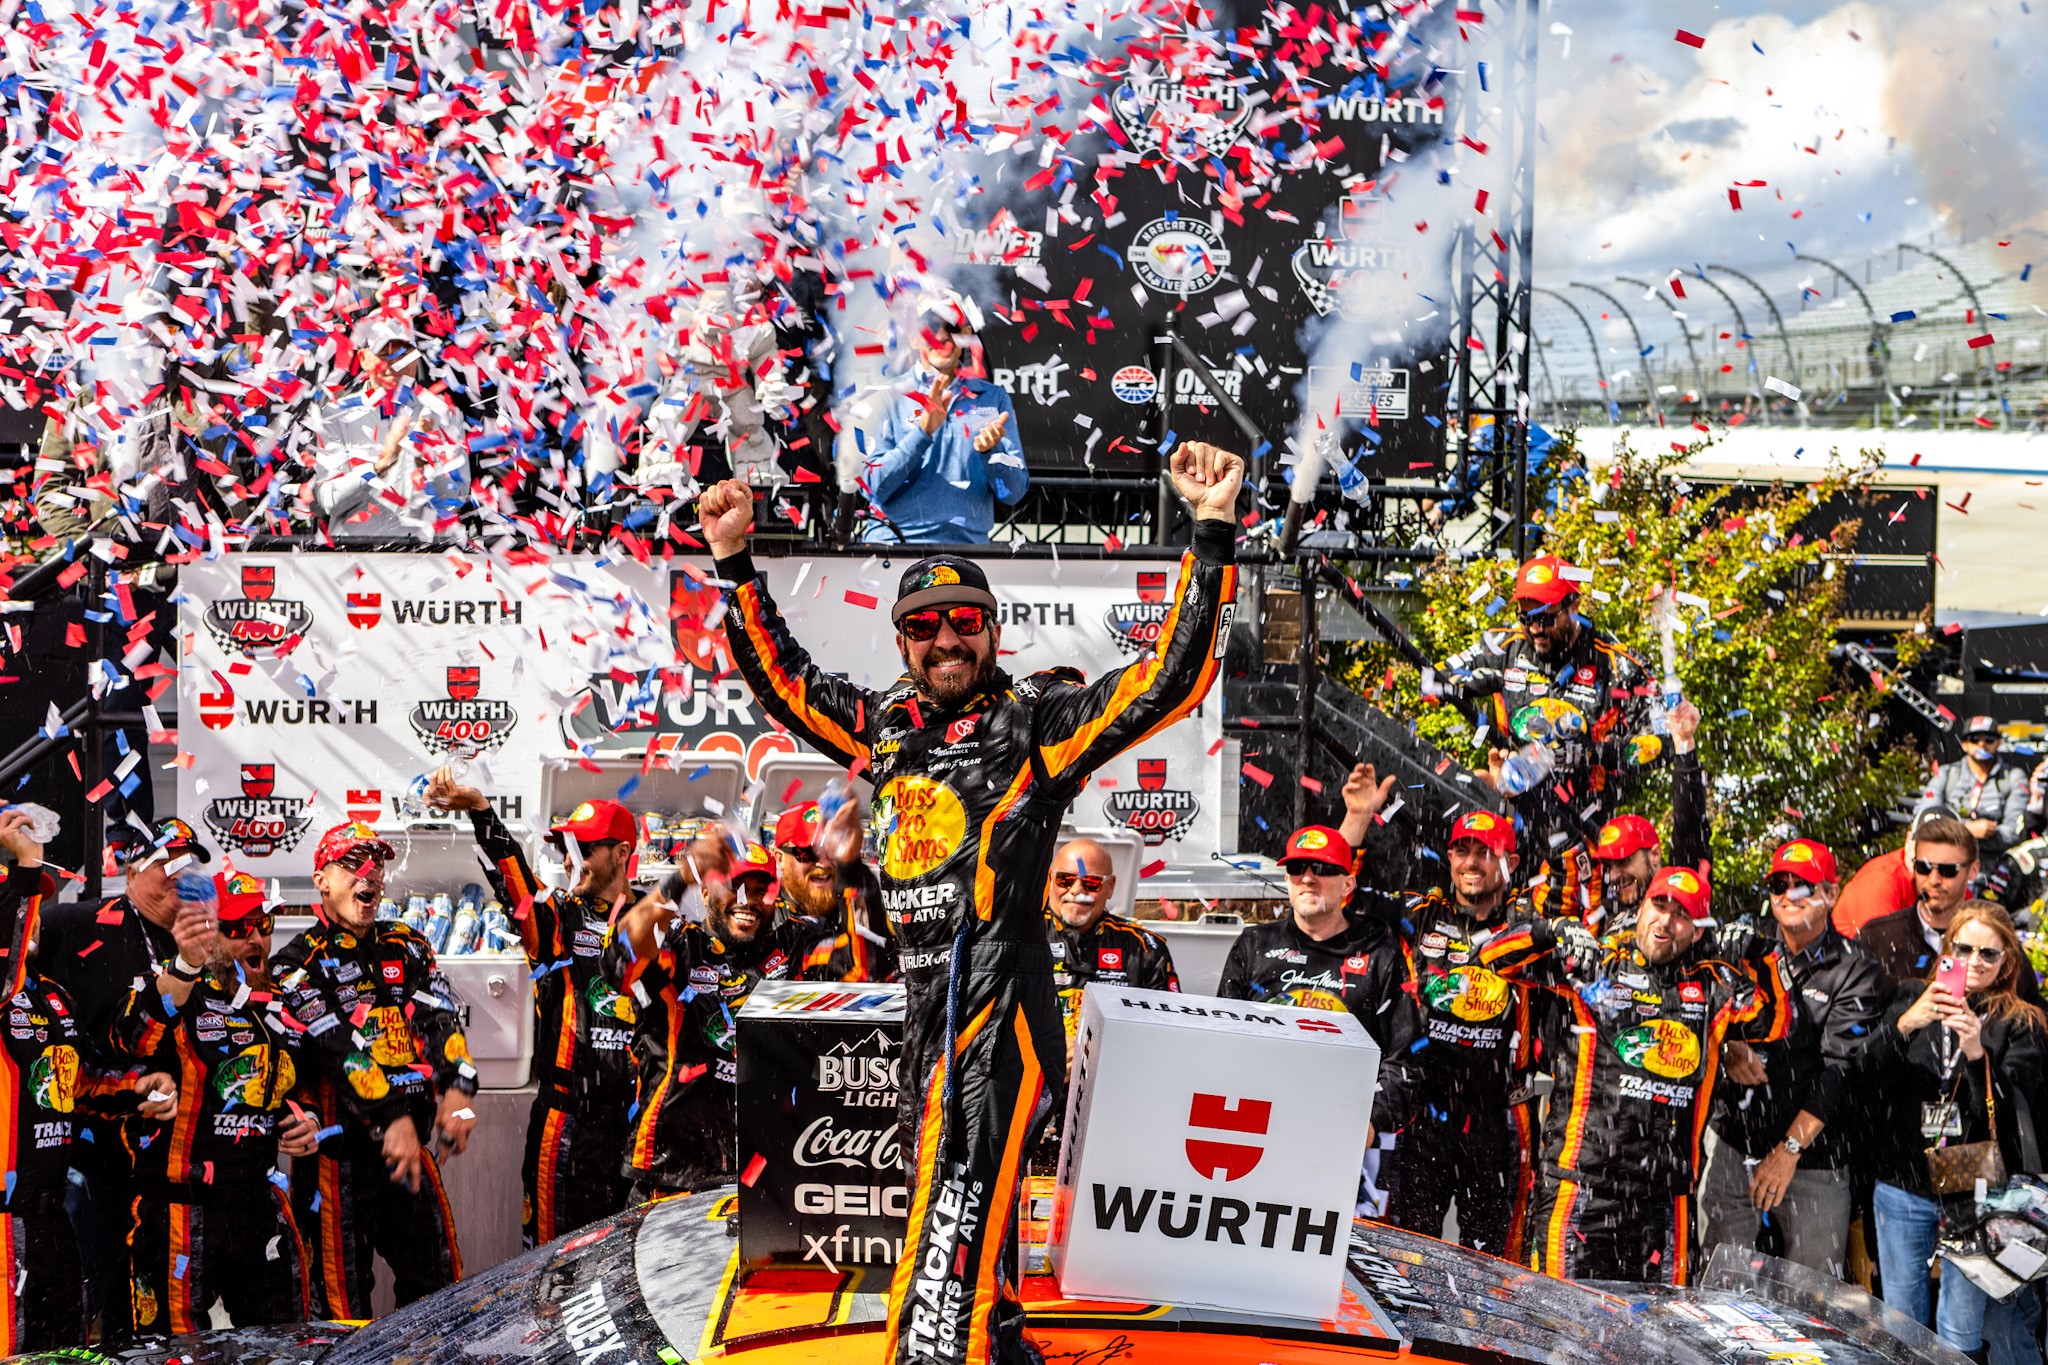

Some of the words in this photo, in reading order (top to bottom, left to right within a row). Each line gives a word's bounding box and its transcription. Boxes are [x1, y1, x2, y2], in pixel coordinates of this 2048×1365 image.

[1141, 220, 1186, 242] NASCAR
[1188, 222, 1217, 244] 75TH
[994, 367, 1058, 394] RTH
[391, 600, 523, 624] WÜRTH
[1128, 622, 1161, 641] 40
[422, 702, 506, 719] WÜRTH
[436, 720, 491, 740] 400
[895, 781, 936, 811] Bass
[1114, 792, 1190, 810] WÜRTH
[216, 800, 301, 818] WÜRTH
[230, 818, 286, 838] 400
[896, 810, 926, 837] Pro
[1127, 810, 1177, 829] 400
[894, 835, 949, 868] Shops
[881, 882, 956, 910] RACKER
[904, 953, 933, 969] TRUEX
[1467, 967, 1497, 983] Bass
[1299, 990, 1334, 1011] Bass
[1463, 996, 1504, 1015] Shops
[1120, 997, 1287, 1027] WÜRTH
[384, 1025, 408, 1040] Pro
[1428, 1018, 1503, 1041] TRACKER
[1428, 1030, 1458, 1043] BOATS
[1658, 1021, 1690, 1041] Bass
[385, 1039, 412, 1055] Sho
[1619, 1073, 1694, 1100] TRACKER
[1619, 1087, 1653, 1101] BOATS
[842, 1091, 900, 1108] LIGH
[794, 1183, 908, 1218] GEIC
[958, 1180, 984, 1243] ATVs
[1092, 1182, 1340, 1257] WÜRTH
[803, 1224, 905, 1274] xfini
